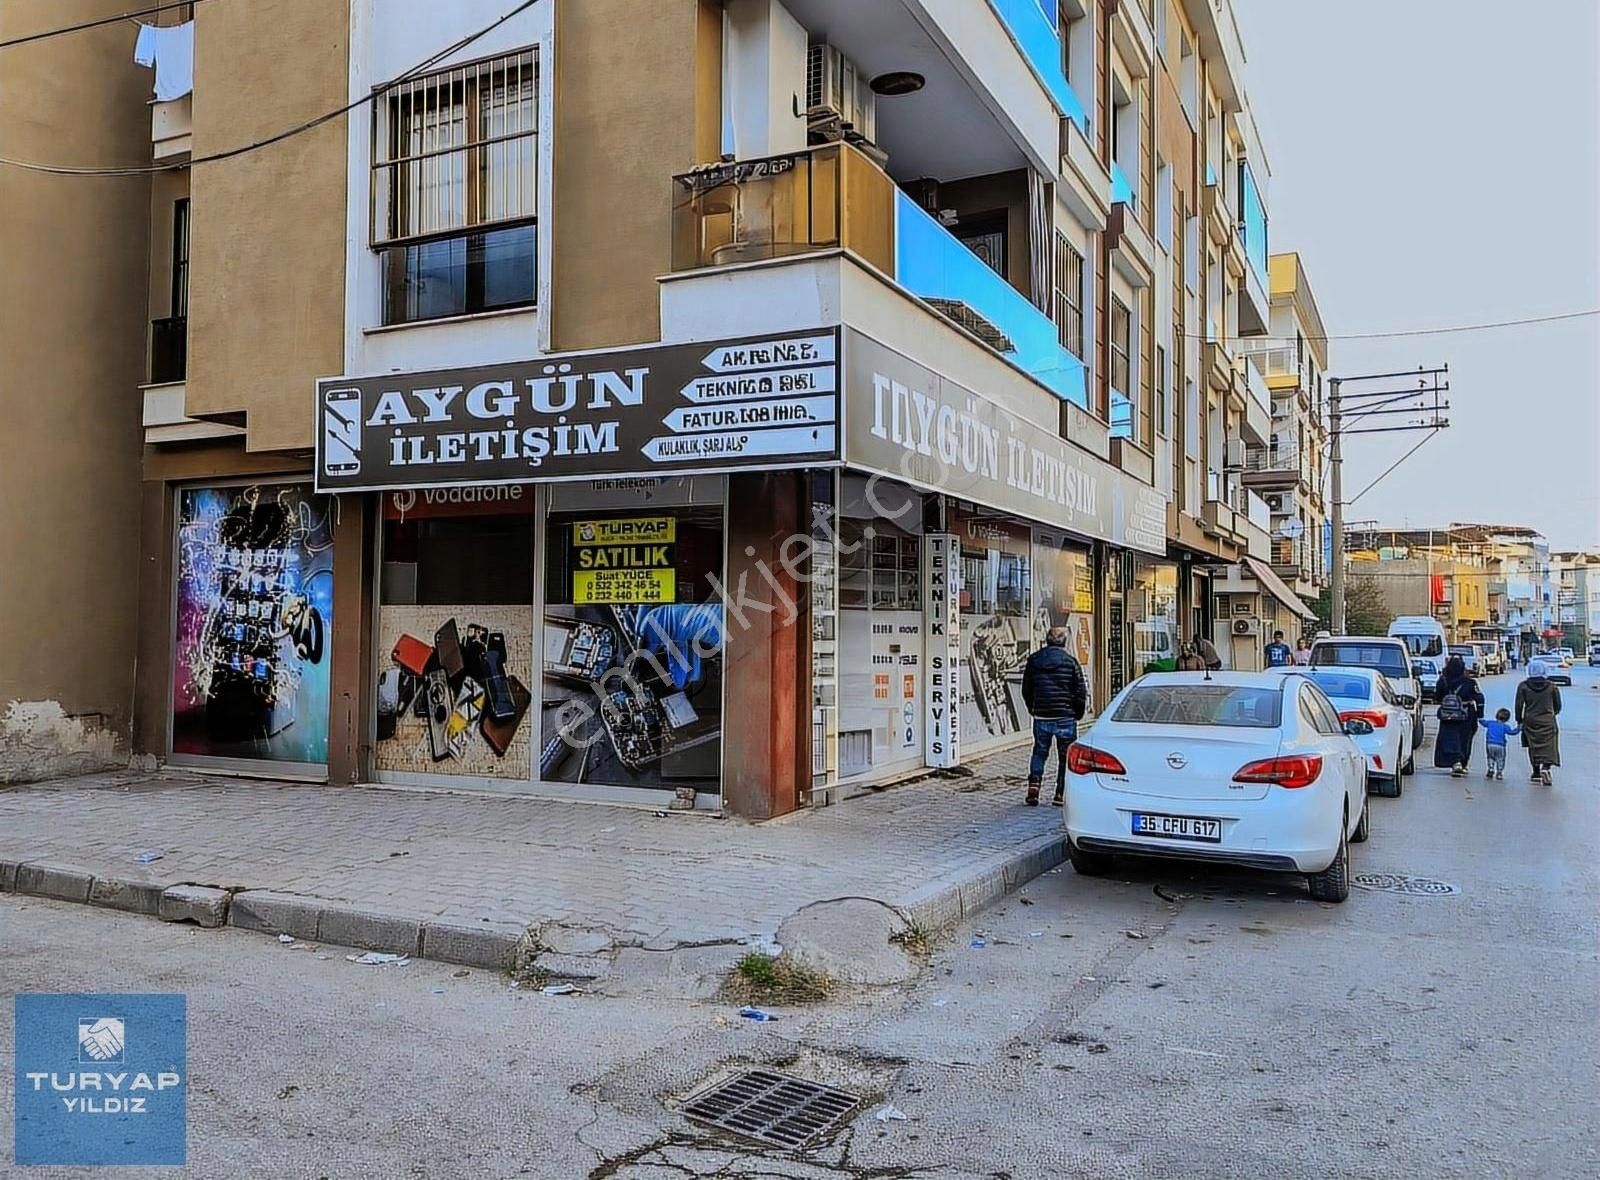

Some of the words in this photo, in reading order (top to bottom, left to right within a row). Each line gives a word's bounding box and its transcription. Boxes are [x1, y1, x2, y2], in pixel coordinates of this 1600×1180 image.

[365, 363, 650, 427] AYGÜN
[388, 416, 620, 466] İLETİŞİM
[1006, 420, 1098, 521] İLETİŞİM
[599, 521, 668, 535] TURYAP
[579, 546, 669, 568] SATILIK
[586, 591, 594, 601] 0
[587, 581, 594, 591] 0
[931, 539, 944, 635] TEKNİK
[931, 656, 943, 754] SERVİS
[1141, 816, 1156, 830] 35
[1163, 819, 1188, 834] CFU
[1193, 821, 1216, 836] 617
